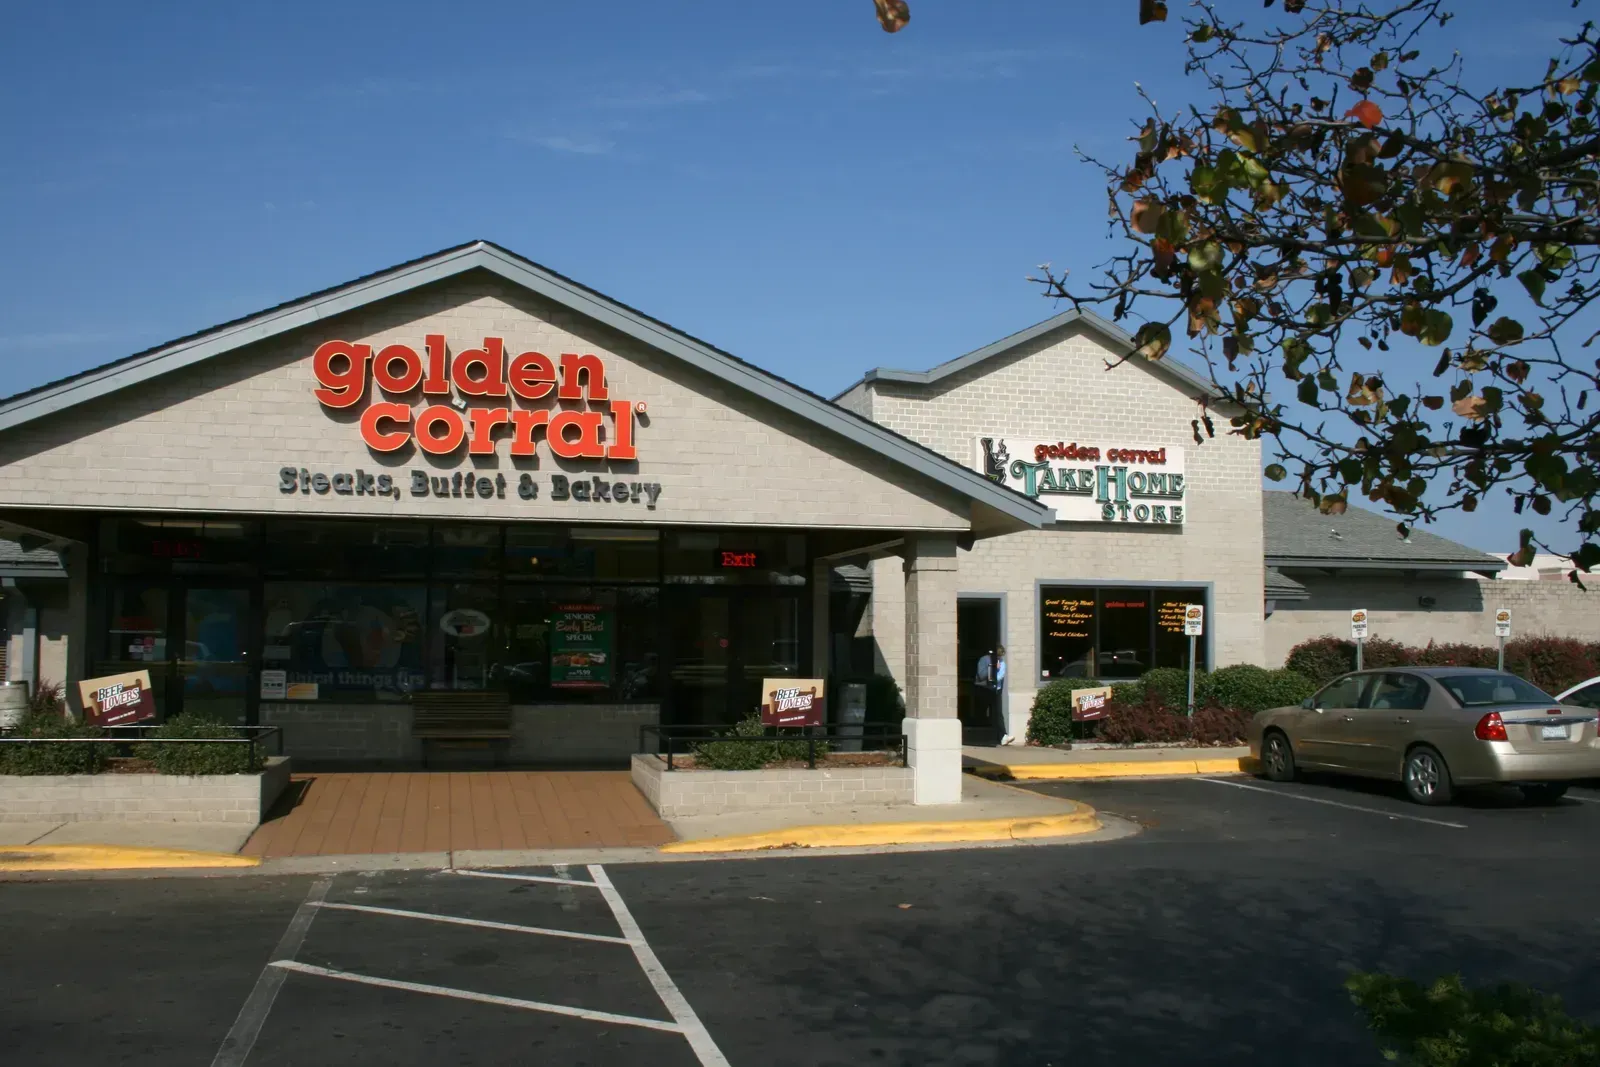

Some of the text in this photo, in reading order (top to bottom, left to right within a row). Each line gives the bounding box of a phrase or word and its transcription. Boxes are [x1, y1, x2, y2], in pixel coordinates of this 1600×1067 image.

[312, 334, 609, 408] golden
[360, 400, 638, 460] corral
[1034, 441, 1168, 464] golden corral
[279, 466, 662, 509] Steaks, Buffet & Bakery
[1101, 503, 1185, 523] STORE
[721, 552, 756, 567] Exit
[97, 682, 124, 702] BEEF
[102, 687, 140, 712] LOVERS
[775, 687, 800, 702] BEEF
[777, 694, 813, 712] LOVERS
